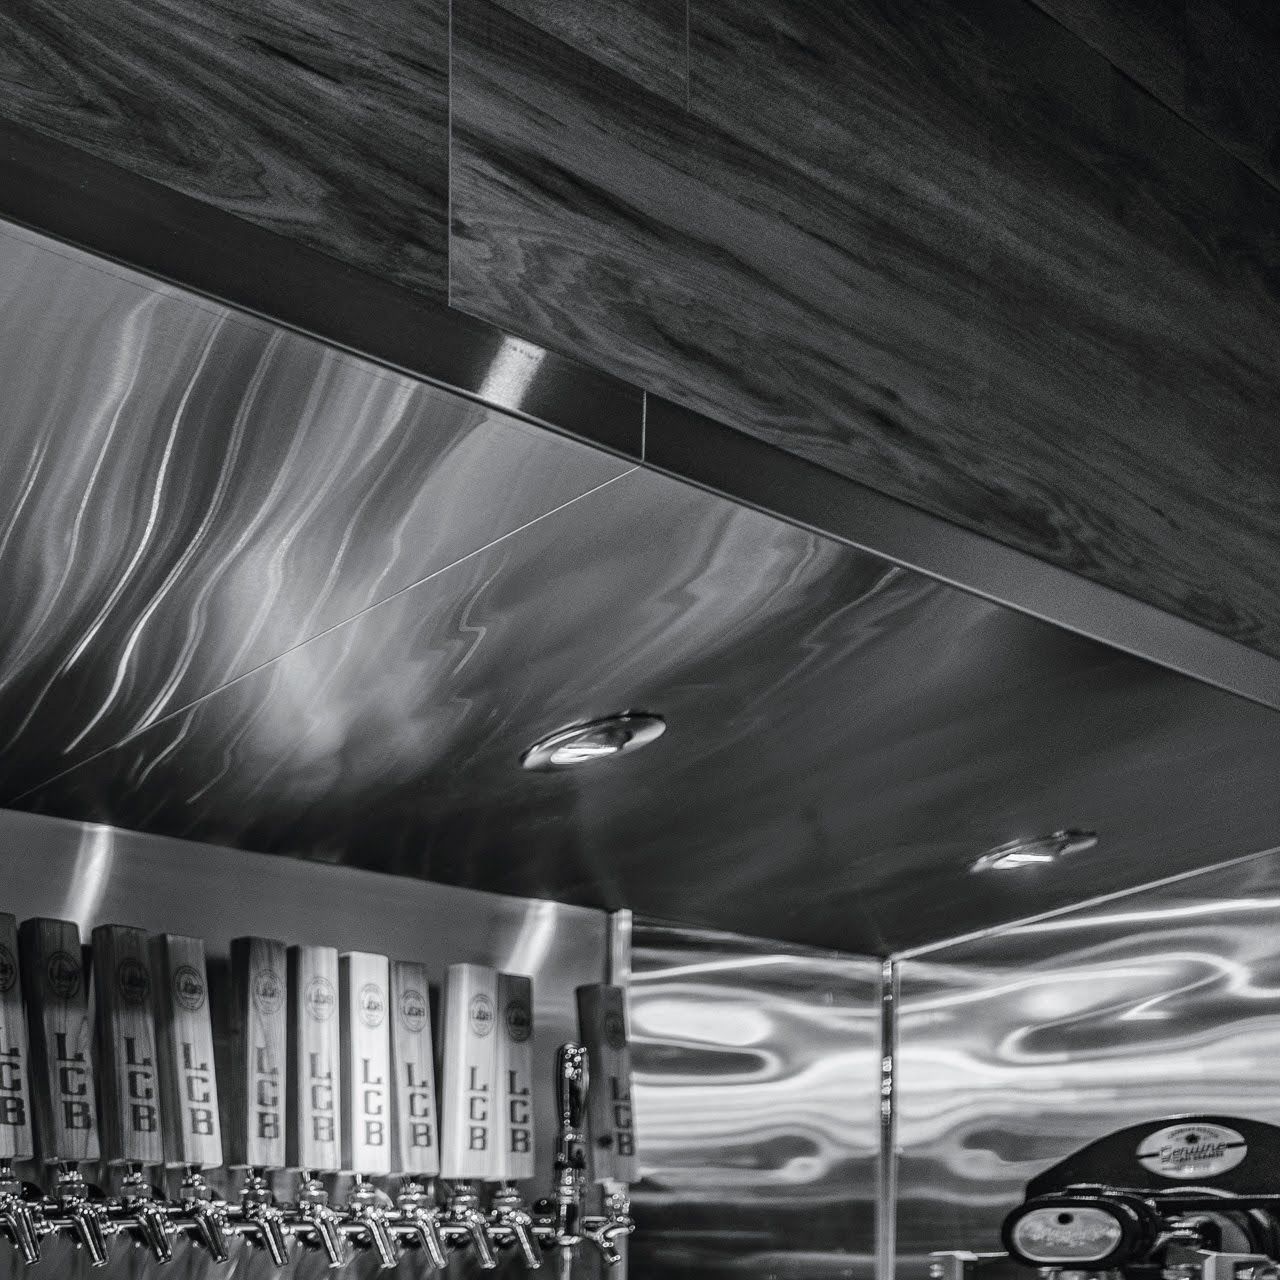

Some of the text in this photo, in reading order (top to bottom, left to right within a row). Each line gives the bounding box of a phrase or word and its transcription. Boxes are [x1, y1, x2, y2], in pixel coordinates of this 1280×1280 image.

[55, 1033, 91, 1129] LCB
[124, 1037, 157, 1132] LCB
[181, 1042, 214, 1136] LCB
[256, 1048, 279, 1139] LCB
[310, 1053, 334, 1142] LCB
[363, 1059, 383, 1146] LCB
[406, 1063, 432, 1147] LCB
[469, 1067, 487, 1151] LCB
[509, 1070, 530, 1153] LCB
